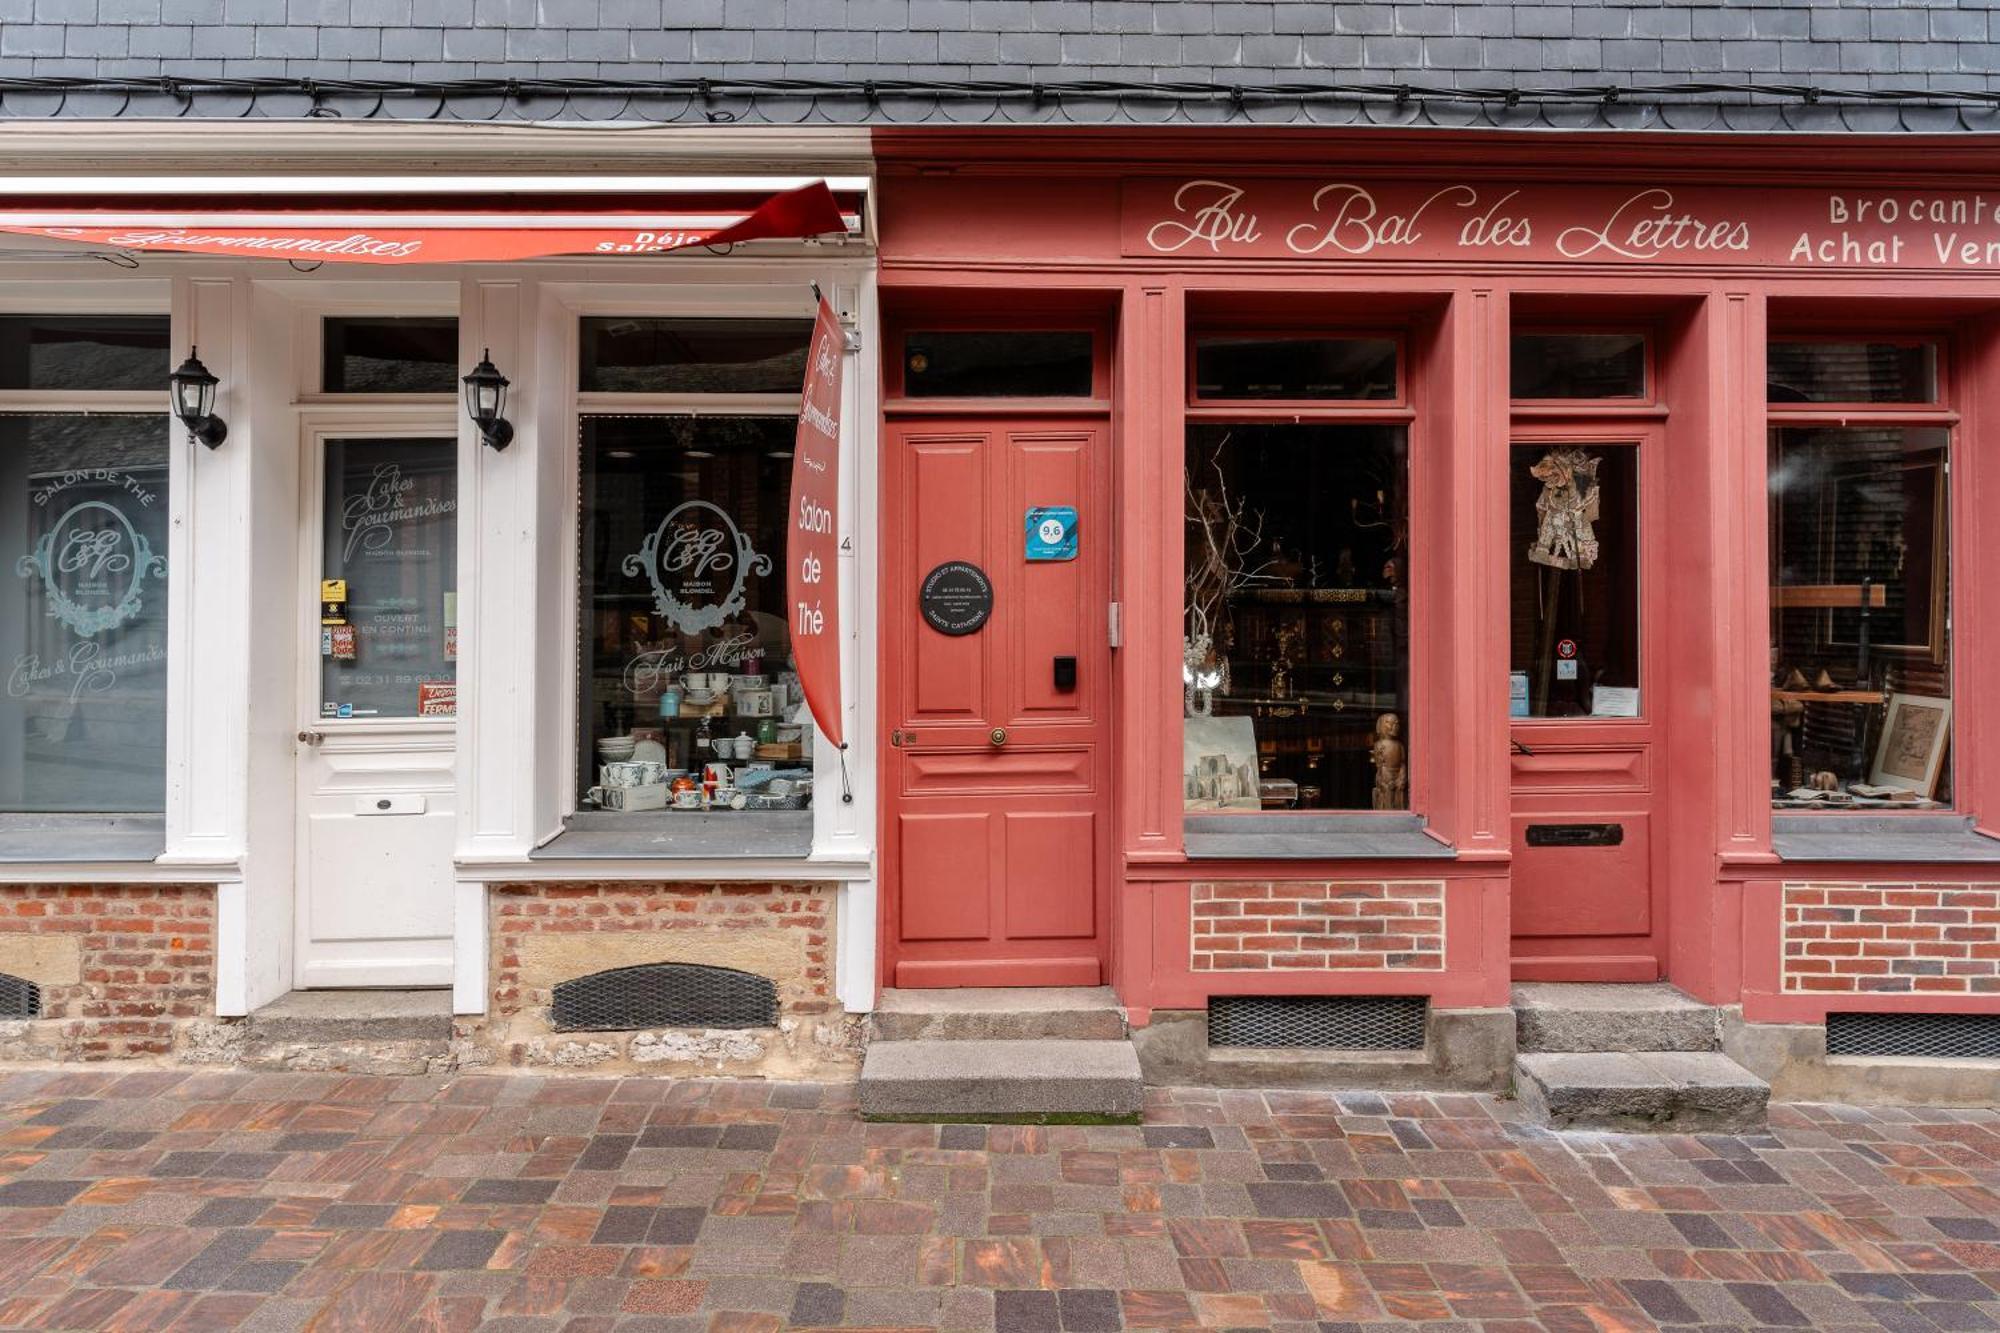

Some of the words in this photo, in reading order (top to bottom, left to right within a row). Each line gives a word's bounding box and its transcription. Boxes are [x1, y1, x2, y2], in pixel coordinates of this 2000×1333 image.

[1146, 180, 1262, 252] Au
[1286, 183, 1477, 254] Bal
[1458, 189, 1531, 247] des
[1555, 188, 1749, 259] Lettres
[1790, 232, 1904, 264] Achat
[34, 469, 89, 506] SALON
[95, 469, 119, 483] DE
[124, 474, 157, 507] THÉ
[366, 461, 416, 511] Cakes
[393, 493, 405, 508] &
[799, 496, 832, 534] Salon
[1043, 526, 1061, 537] 9,6
[840, 536, 852, 551] 4
[802, 552, 821, 583] de
[798, 600, 824, 635] Thé
[623, 646, 684, 694] Fait
[688, 632, 766, 670] Maison
